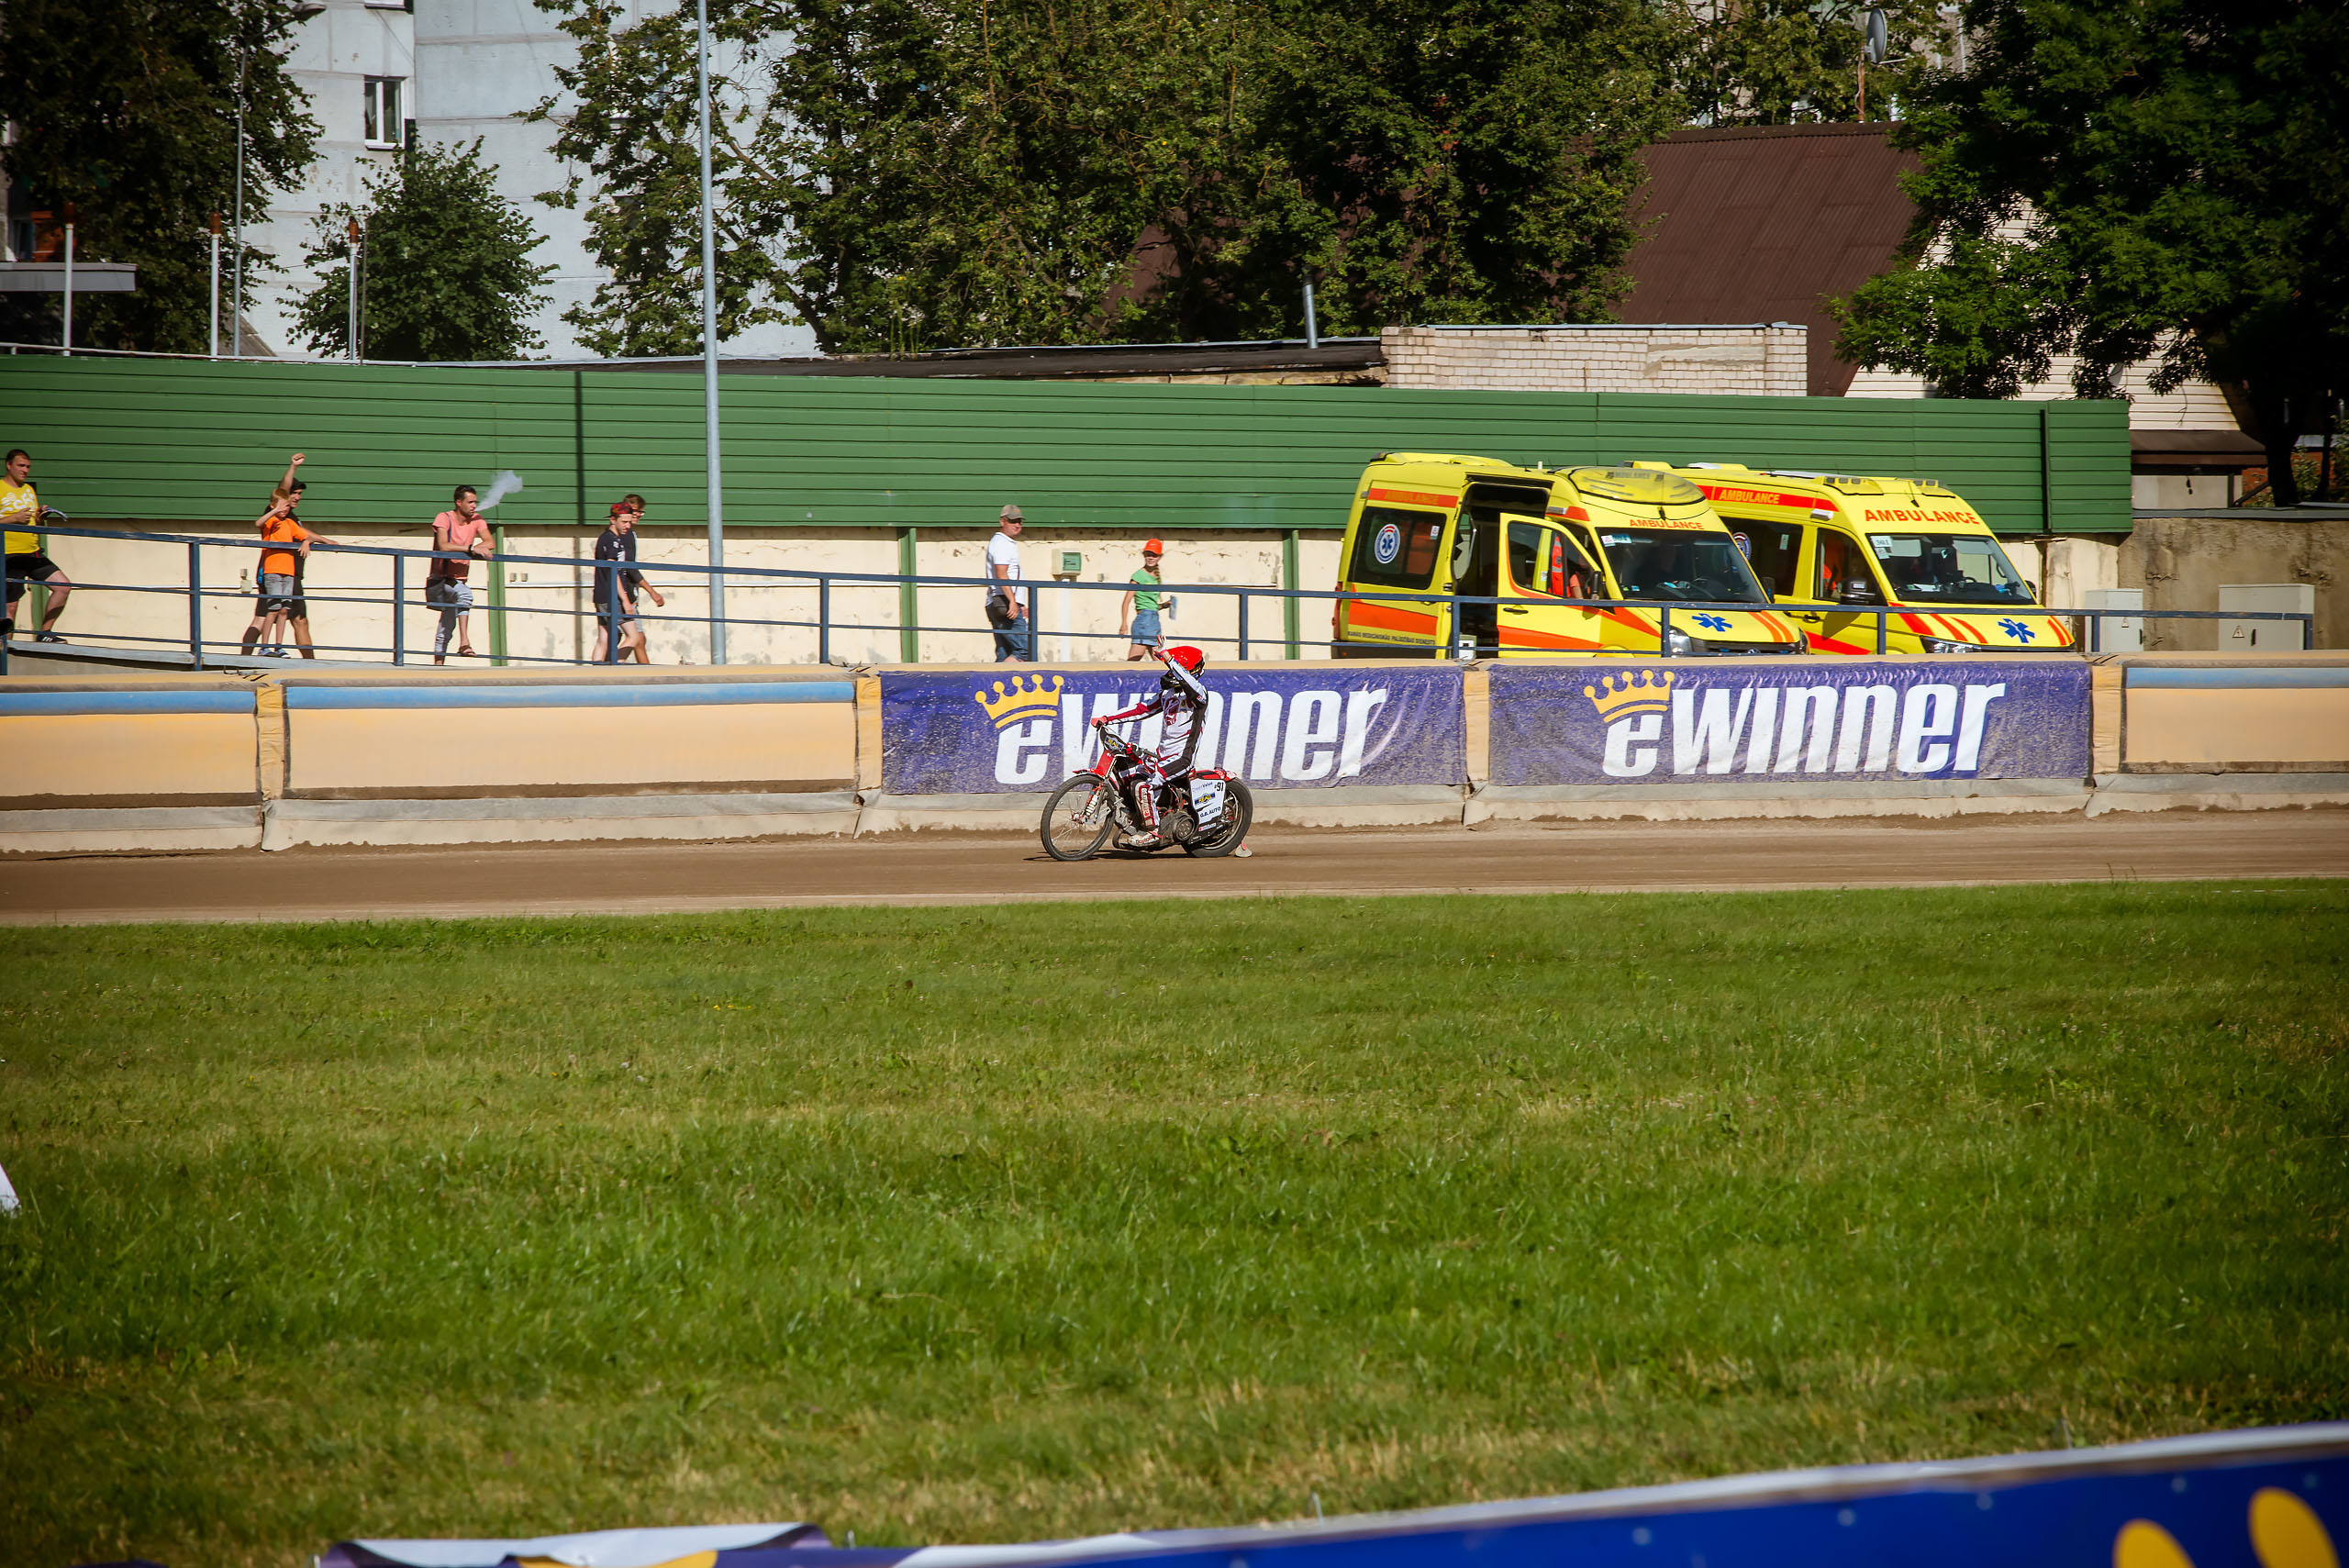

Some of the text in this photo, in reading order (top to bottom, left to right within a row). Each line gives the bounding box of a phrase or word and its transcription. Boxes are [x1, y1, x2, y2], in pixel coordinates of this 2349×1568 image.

[1384, 490, 1440, 506] AMBULANCE
[1719, 489, 1781, 505] AMBULANCE
[1630, 518, 1705, 530] AMBULANCE
[1865, 509, 1980, 525] AMBULANCE
[1601, 682, 2006, 778] ewinner
